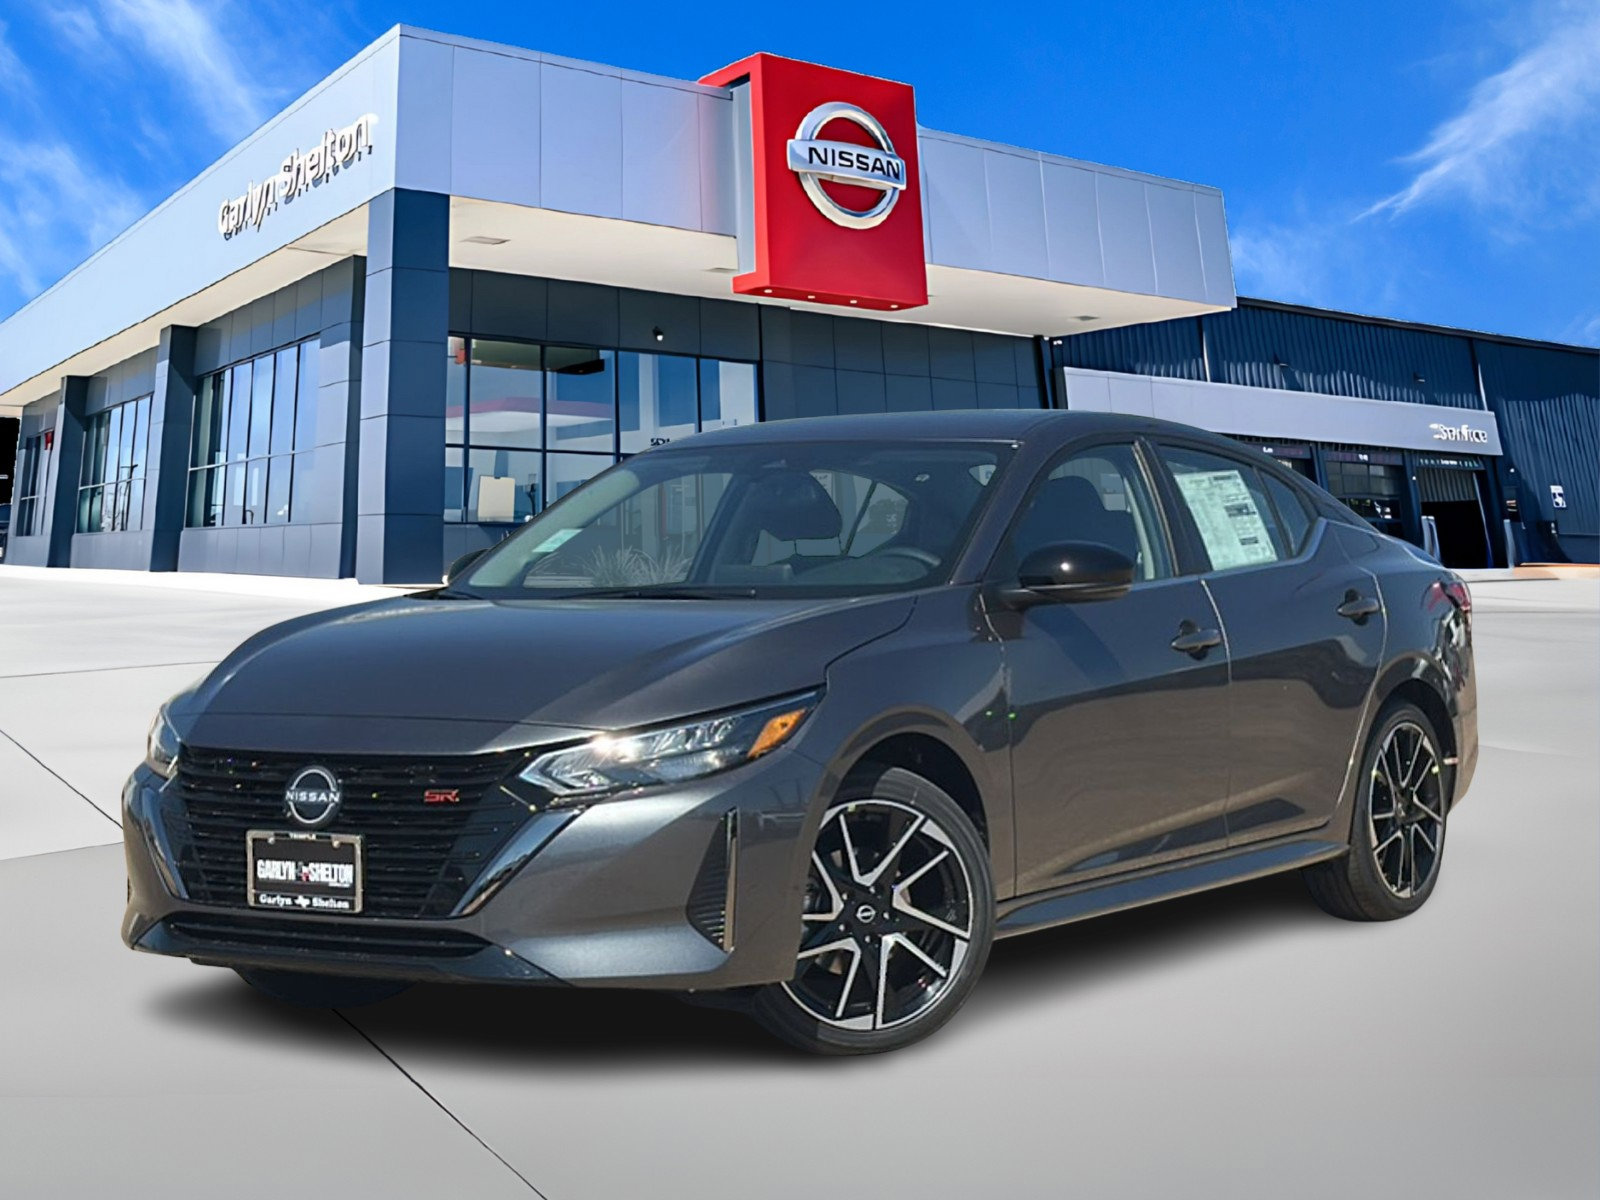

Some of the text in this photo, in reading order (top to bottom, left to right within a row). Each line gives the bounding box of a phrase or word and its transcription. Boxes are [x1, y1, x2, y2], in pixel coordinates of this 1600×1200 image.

[279, 114, 374, 203] Shelton
[808, 146, 901, 181] NISSAN
[285, 790, 341, 803] NISSAN
[257, 859, 354, 884] GARLYN SHELTON
